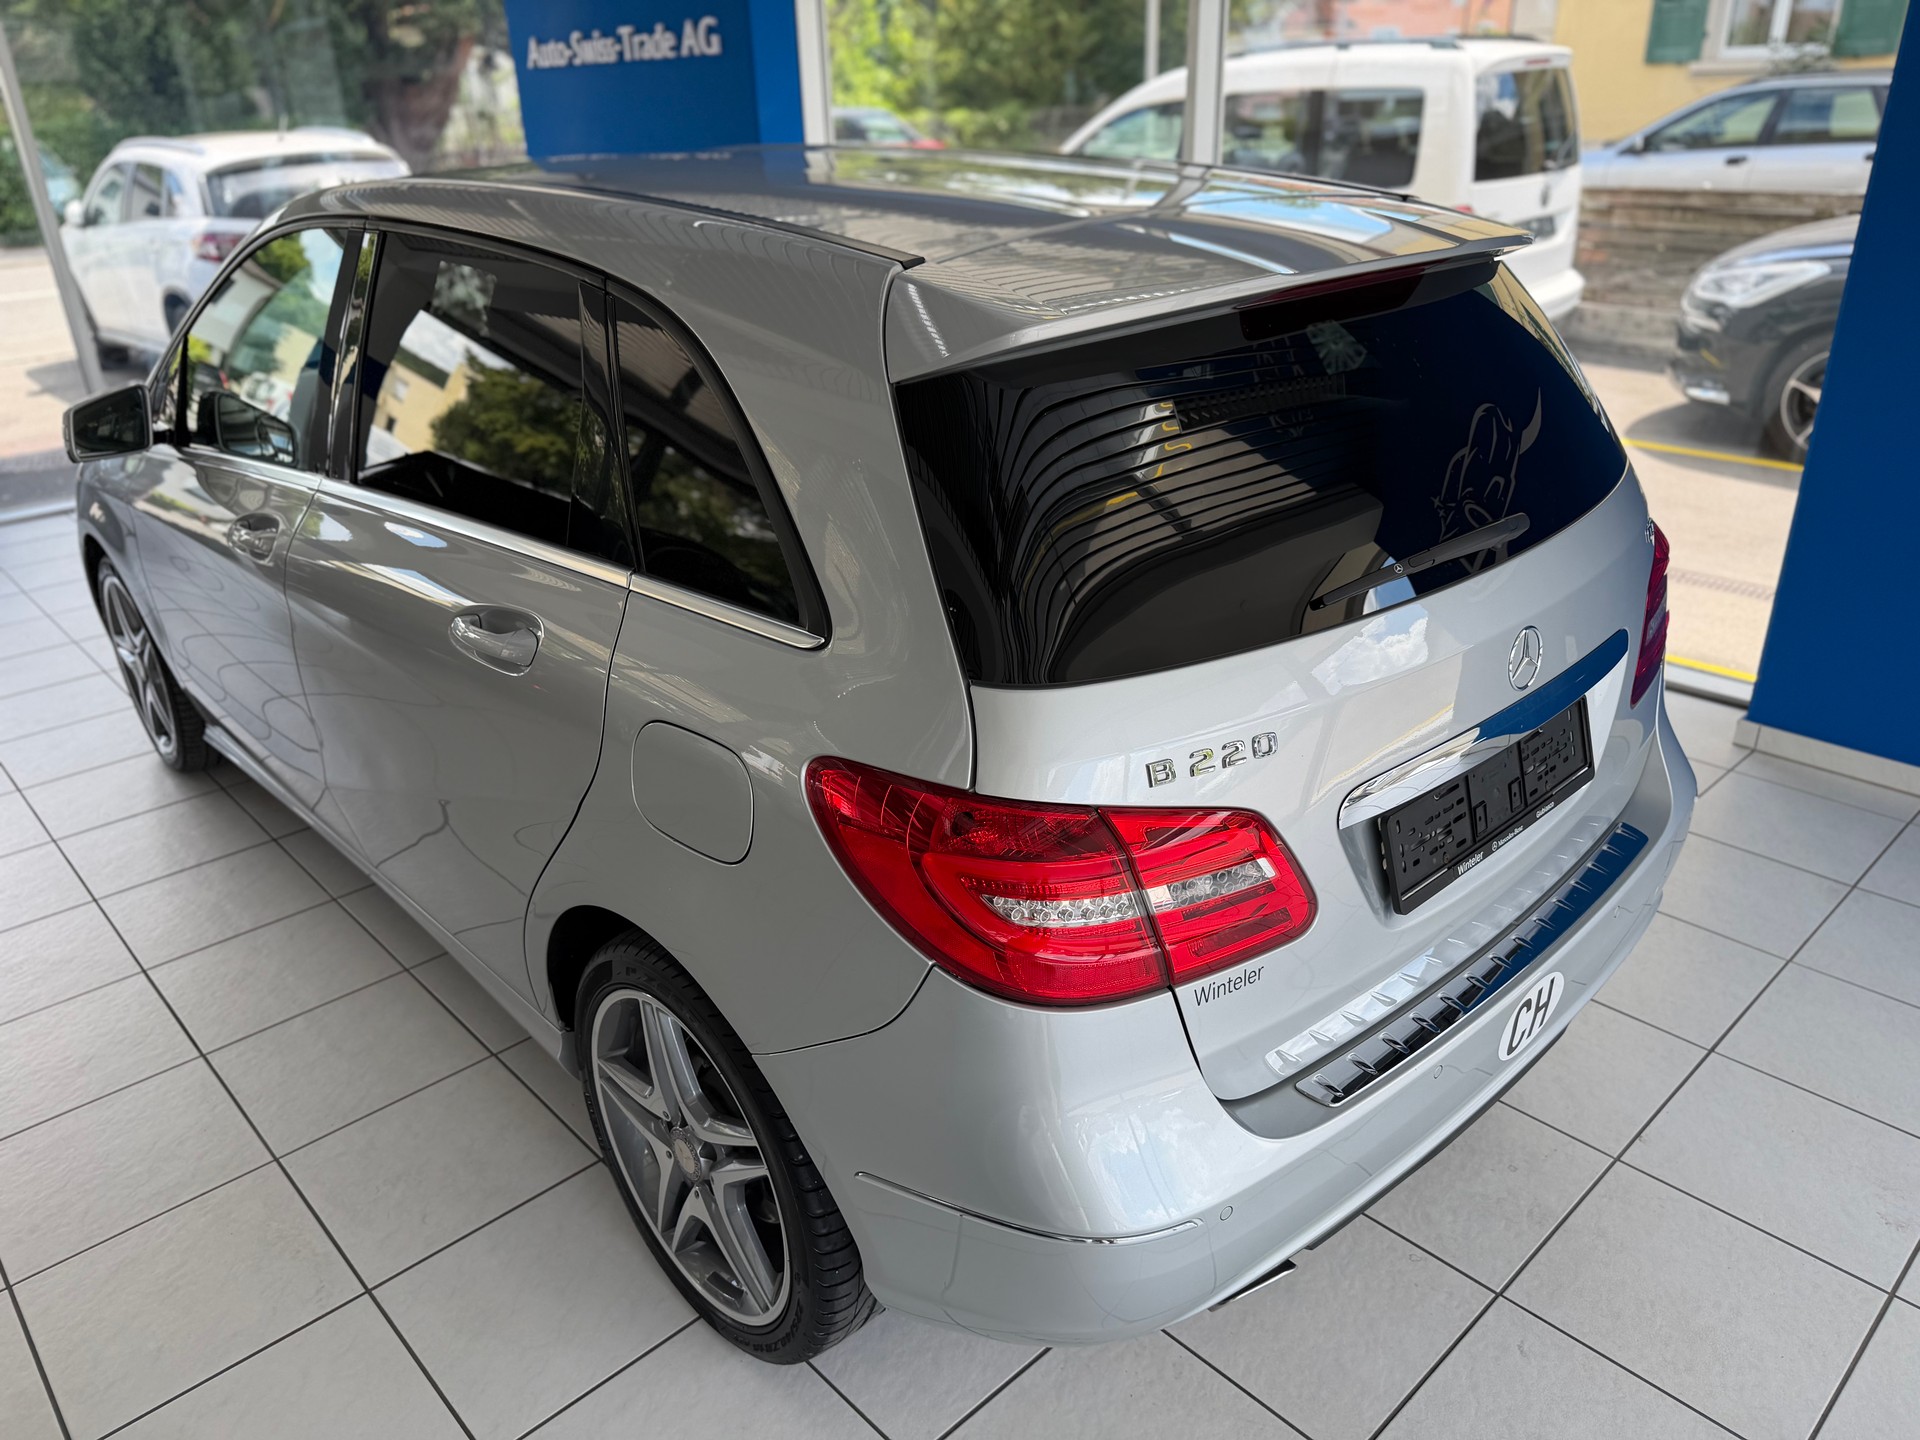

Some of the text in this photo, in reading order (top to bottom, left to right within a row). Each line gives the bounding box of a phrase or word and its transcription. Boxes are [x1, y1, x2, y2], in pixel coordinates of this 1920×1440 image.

[527, 15, 723, 69] Auto-Swiss-Trade AG
[1145, 731, 1278, 788] B 220
[1457, 851, 1484, 875] Winteler
[1194, 966, 1264, 1006] Winteler
[1507, 976, 1555, 1056] CH
